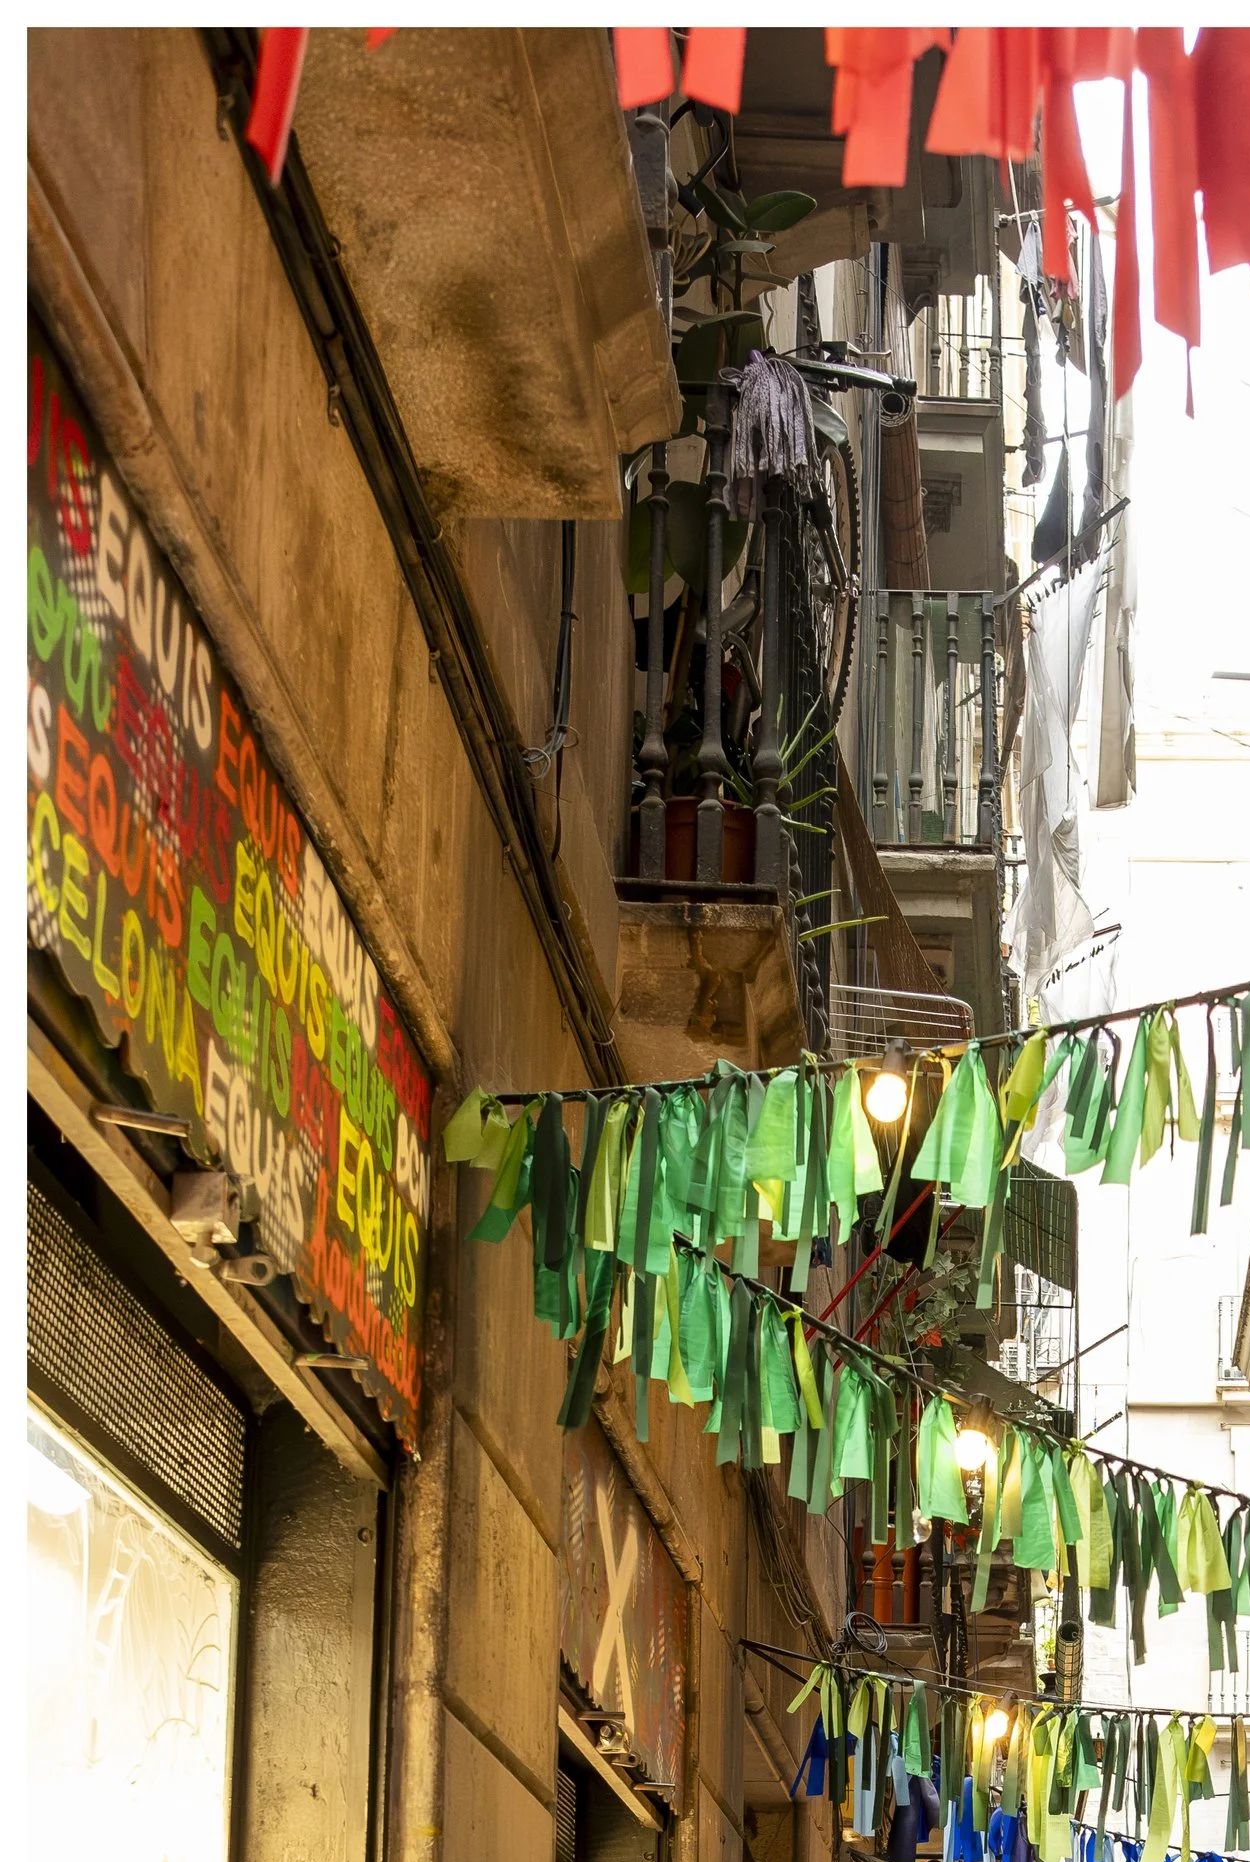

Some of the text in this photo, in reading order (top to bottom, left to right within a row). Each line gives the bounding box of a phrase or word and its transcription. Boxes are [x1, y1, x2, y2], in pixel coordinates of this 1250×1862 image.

[97, 472, 213, 749] EQUIS
[216, 690, 301, 898] EQUIS
[303, 843, 378, 1049] EQUIS
[56, 703, 185, 948] EQUIS
[187, 885, 292, 1118] EQUIS
[337, 1103, 419, 1307] EQUIS
[204, 1038, 304, 1245] EQUIS
[234, 840, 327, 1061] EQUIS
[330, 995, 396, 1171] EQUIS
[396, 1112, 431, 1230] BCN
